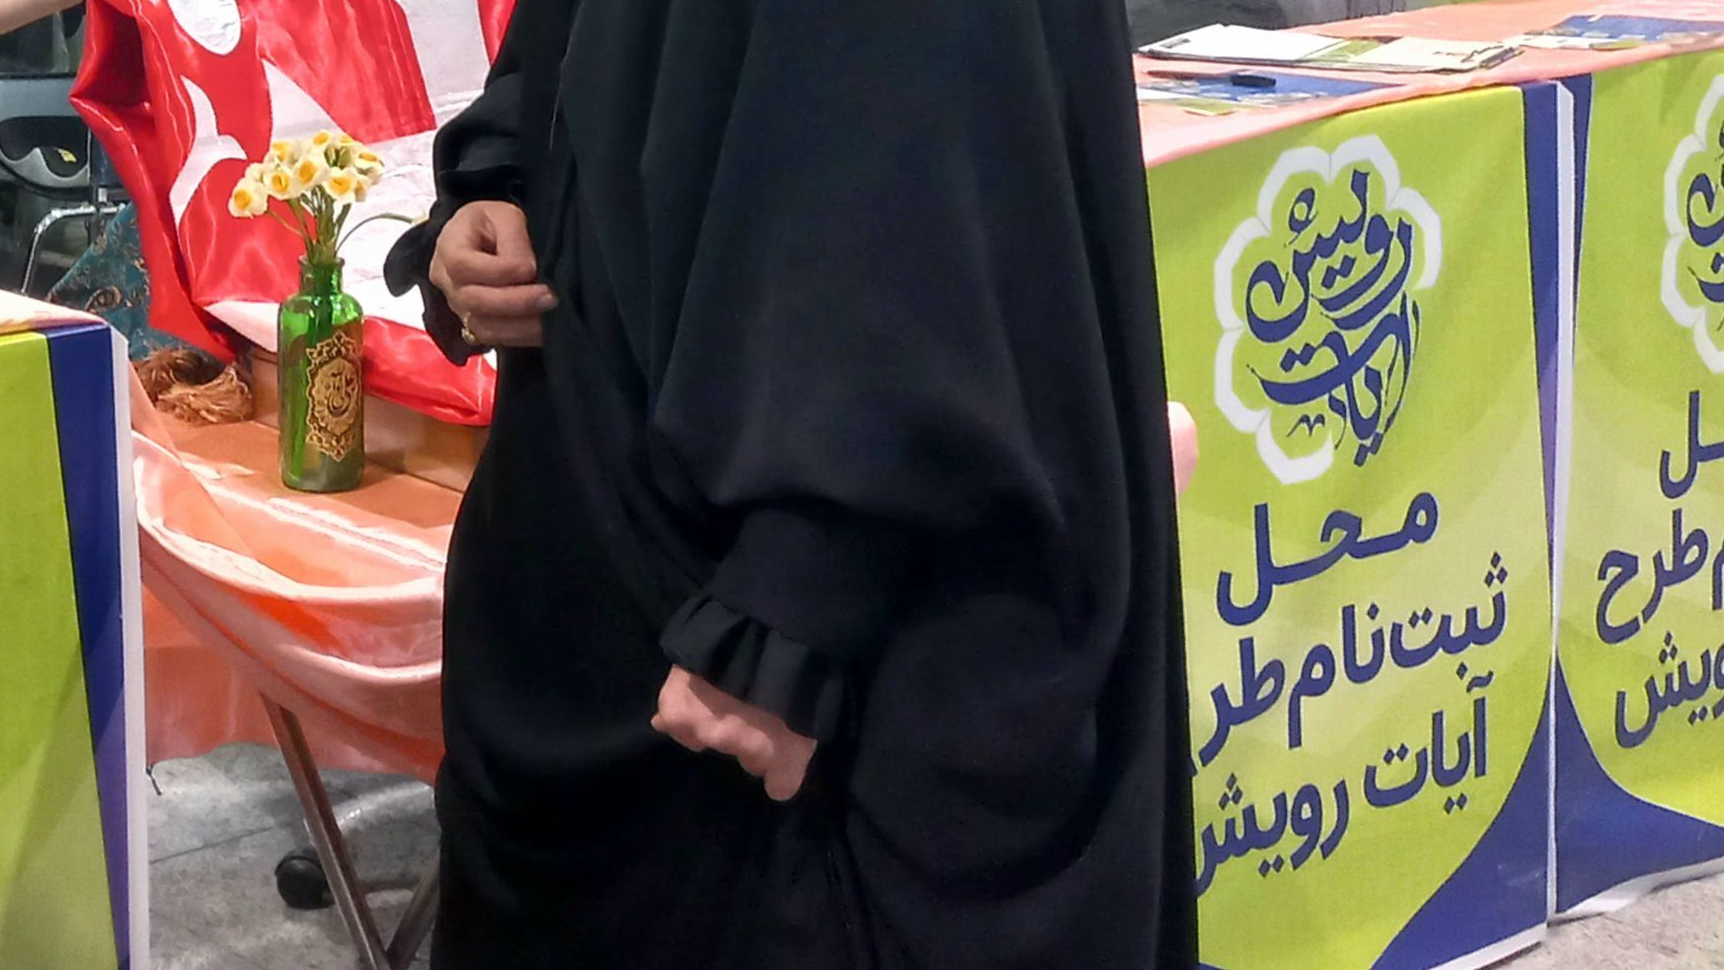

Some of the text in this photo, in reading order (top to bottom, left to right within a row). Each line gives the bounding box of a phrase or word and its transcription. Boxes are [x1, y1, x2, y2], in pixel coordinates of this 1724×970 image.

[1217, 492, 1438, 626] محل
[1596, 507, 1709, 644] طرح
[1363, 670, 1494, 814] آیات
